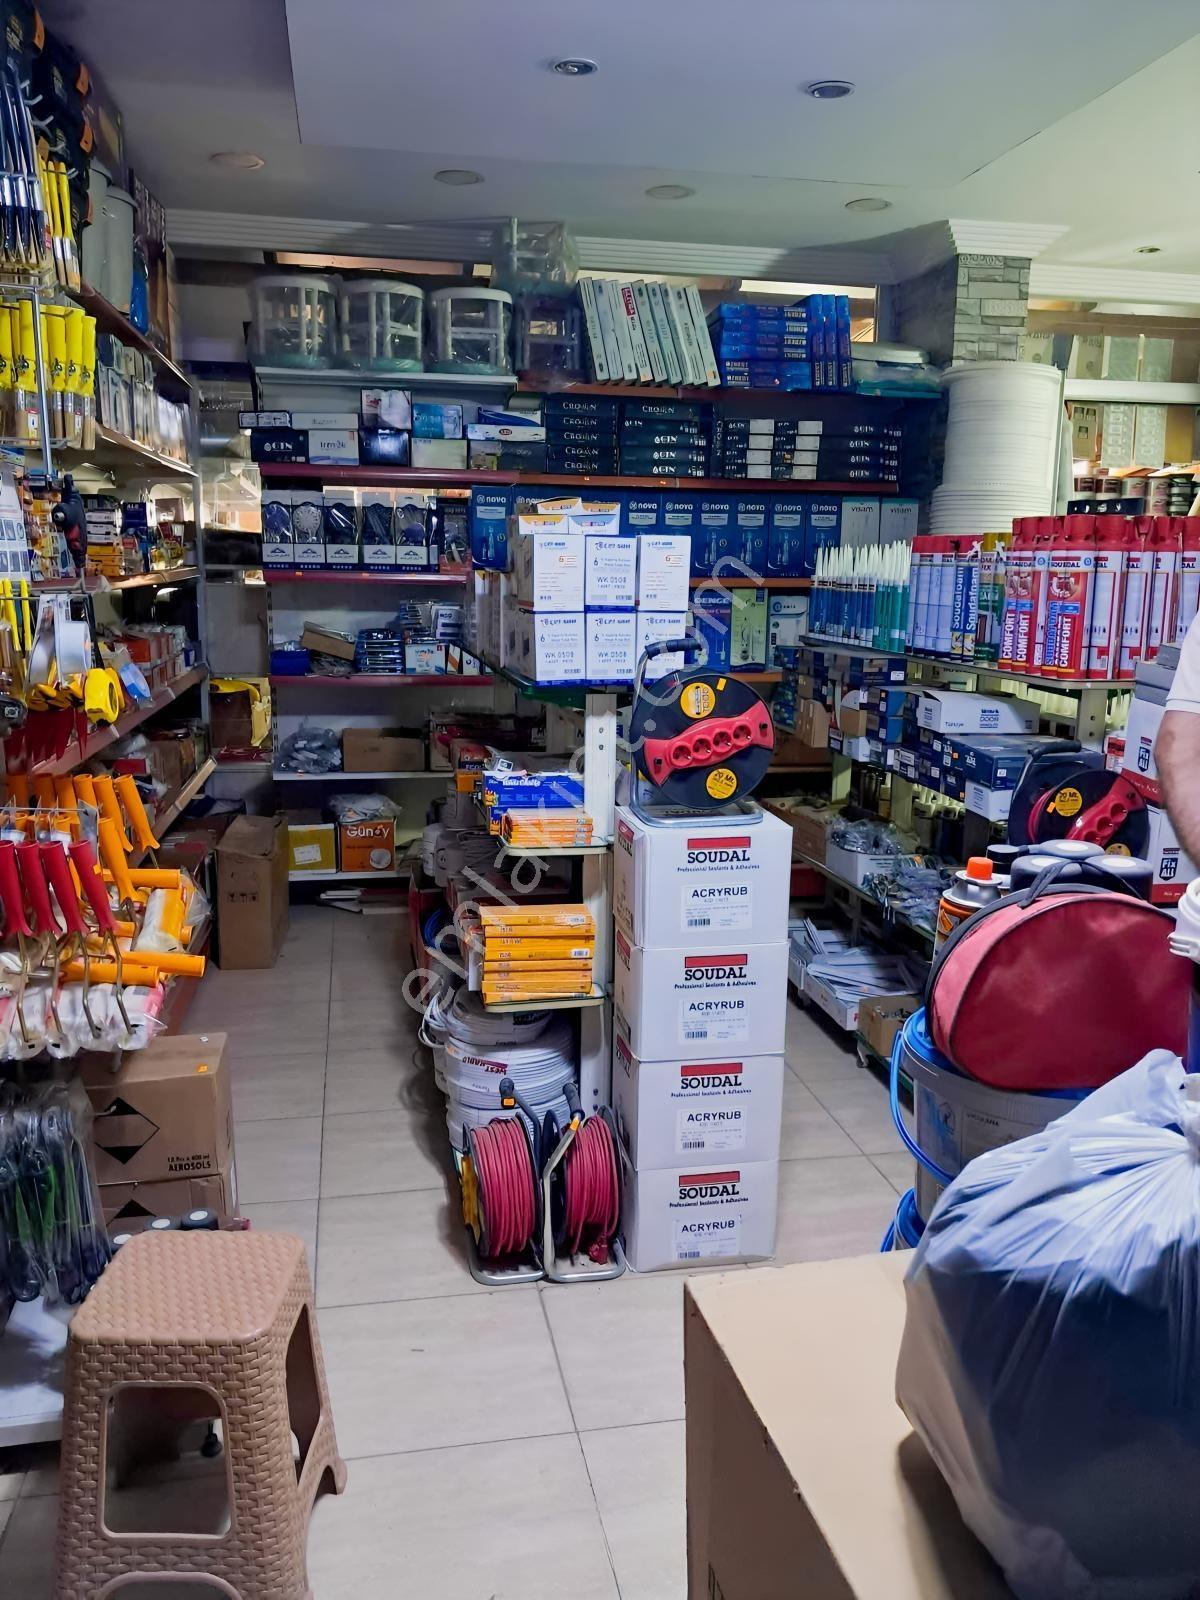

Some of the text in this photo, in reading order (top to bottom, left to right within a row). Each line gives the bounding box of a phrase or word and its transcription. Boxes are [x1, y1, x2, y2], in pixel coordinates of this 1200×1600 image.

[486, 495, 507, 504] nova
[952, 567, 965, 629] Soudafoam
[966, 567, 979, 631] Soudafoam
[1002, 612, 1016, 659] COMFORT
[1016, 613, 1030, 662] COMFORT
[1059, 616, 1072, 668] COMFORT
[687, 849, 751, 864] SOUDAL
[1162, 858, 1176, 868] Fix
[691, 886, 748, 898] ACRYRUB
[684, 966, 747, 981] SOUDAL
[688, 1000, 745, 1011] ACRYRUB
[680, 1075, 742, 1090] SOUDAL
[687, 1110, 742, 1122] ACRYRUB
[168, 1160, 211, 1172] AEROSOLS
[679, 1184, 740, 1200] SOUDAL
[681, 1220, 735, 1233] ACRYRUB
